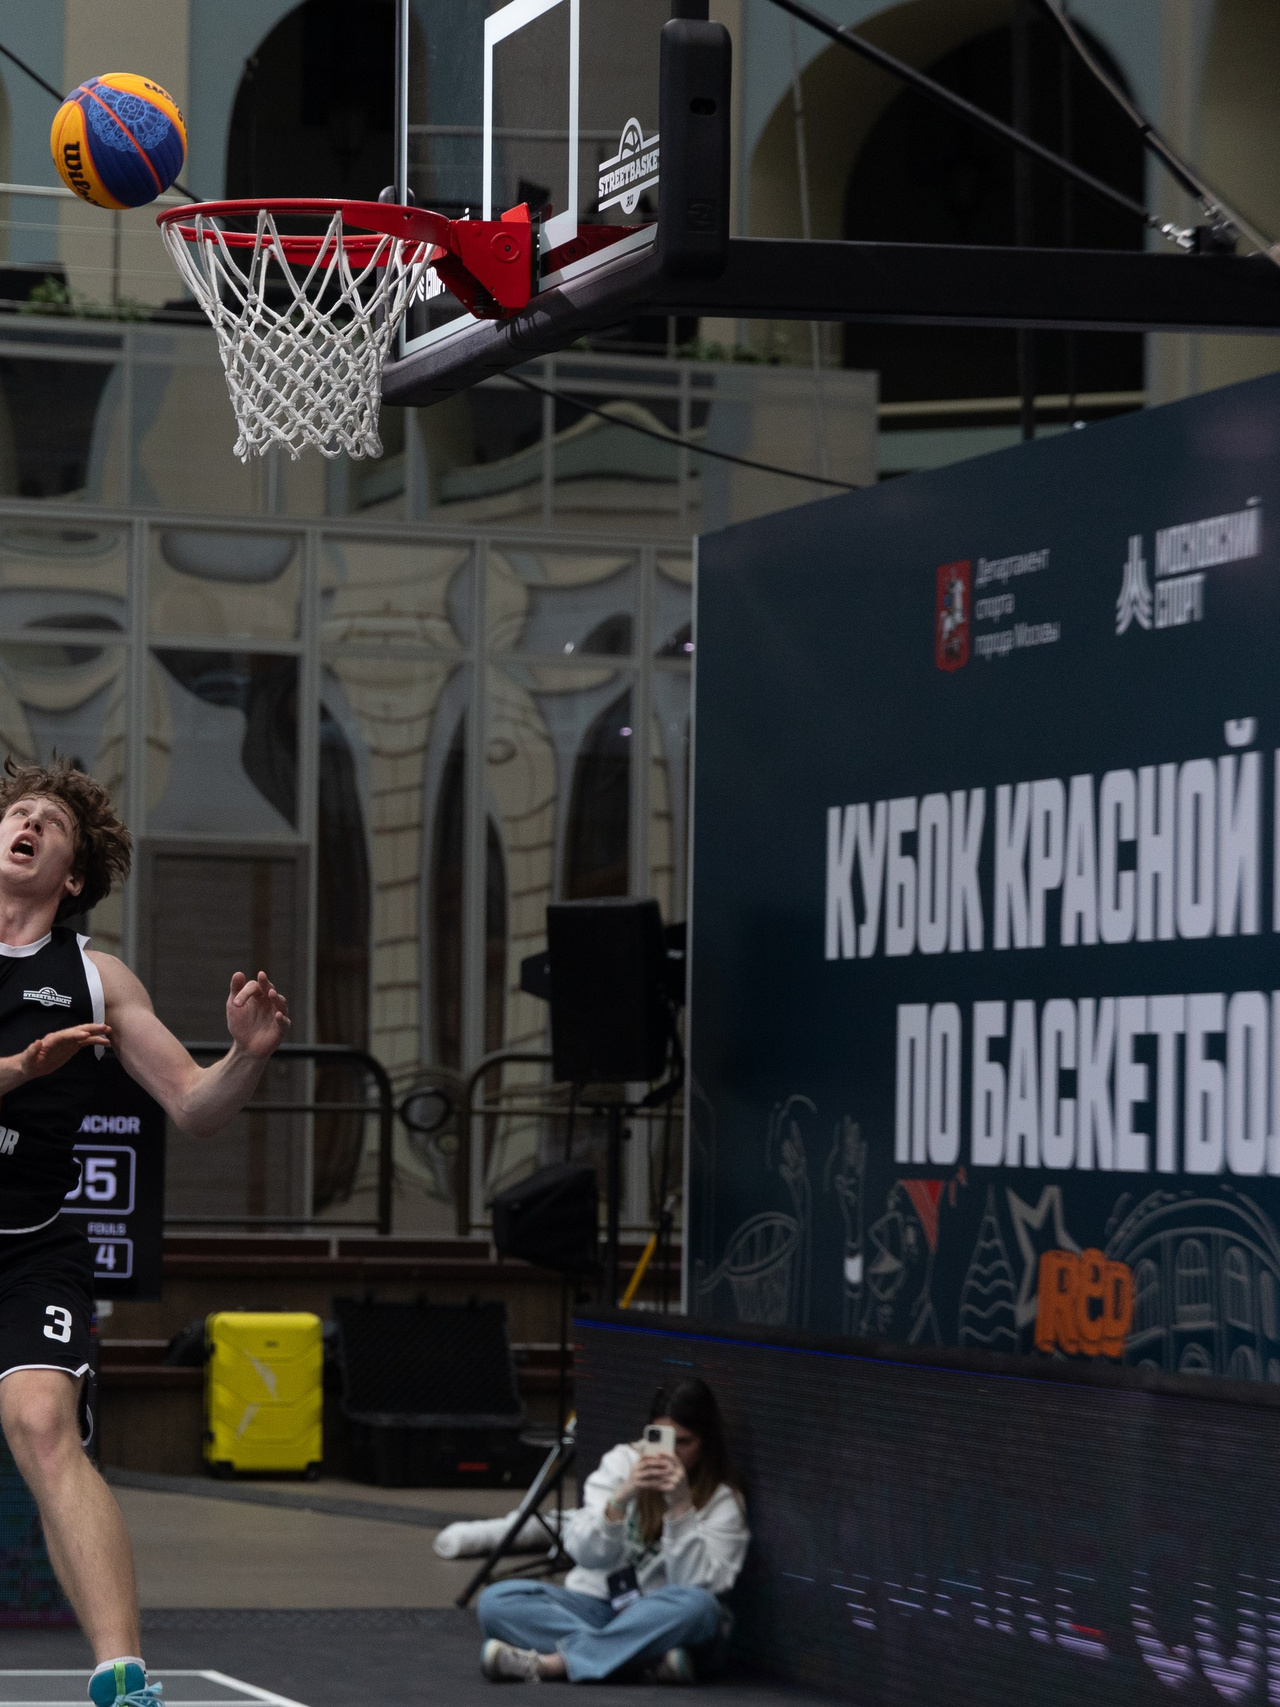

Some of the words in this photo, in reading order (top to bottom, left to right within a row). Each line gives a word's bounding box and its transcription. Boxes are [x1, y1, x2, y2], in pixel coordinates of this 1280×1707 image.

[598, 147, 660, 199] STREETBASKE
[825, 788, 987, 960] КУБОК
[993, 716, 1263, 951] КРАСНОЙ
[894, 1002, 962, 1165] ПО
[87, 1222, 127, 1236] FOULS
[95, 1244, 117, 1271] 4
[43, 1304, 73, 1344] 3
